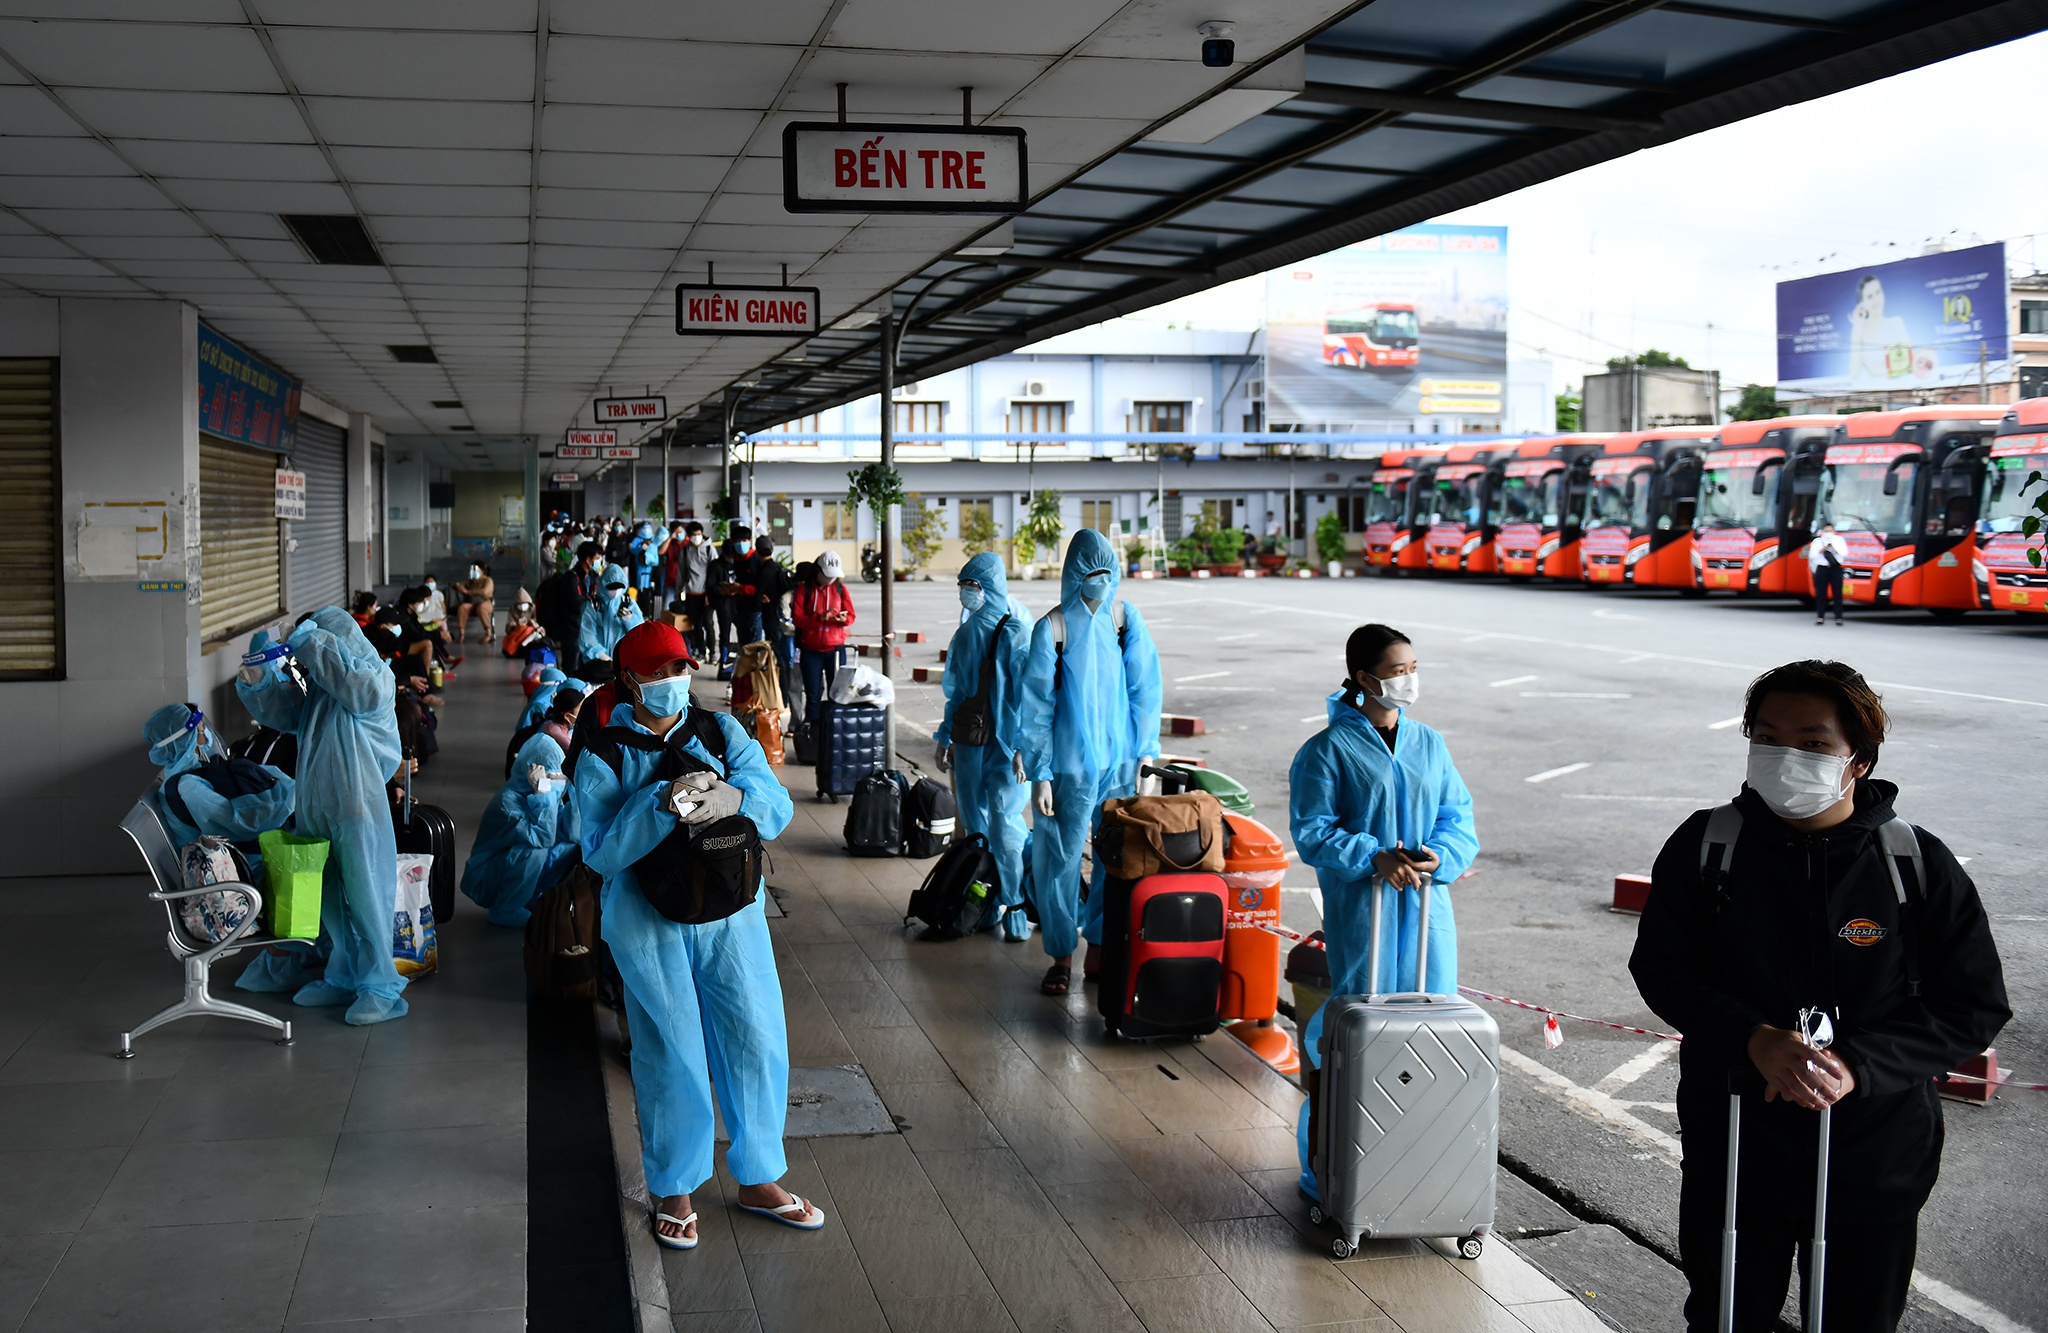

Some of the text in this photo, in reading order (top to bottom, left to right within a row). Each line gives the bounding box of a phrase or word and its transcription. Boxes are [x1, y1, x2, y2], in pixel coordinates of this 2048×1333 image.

[835, 136, 986, 189] BẾN TRE
[689, 293, 807, 324] KIÊN GIANG
[607, 402, 656, 417] TRÀ VINH
[570, 431, 592, 443] VŨNG
[703, 833, 747, 850] SUZUKI
